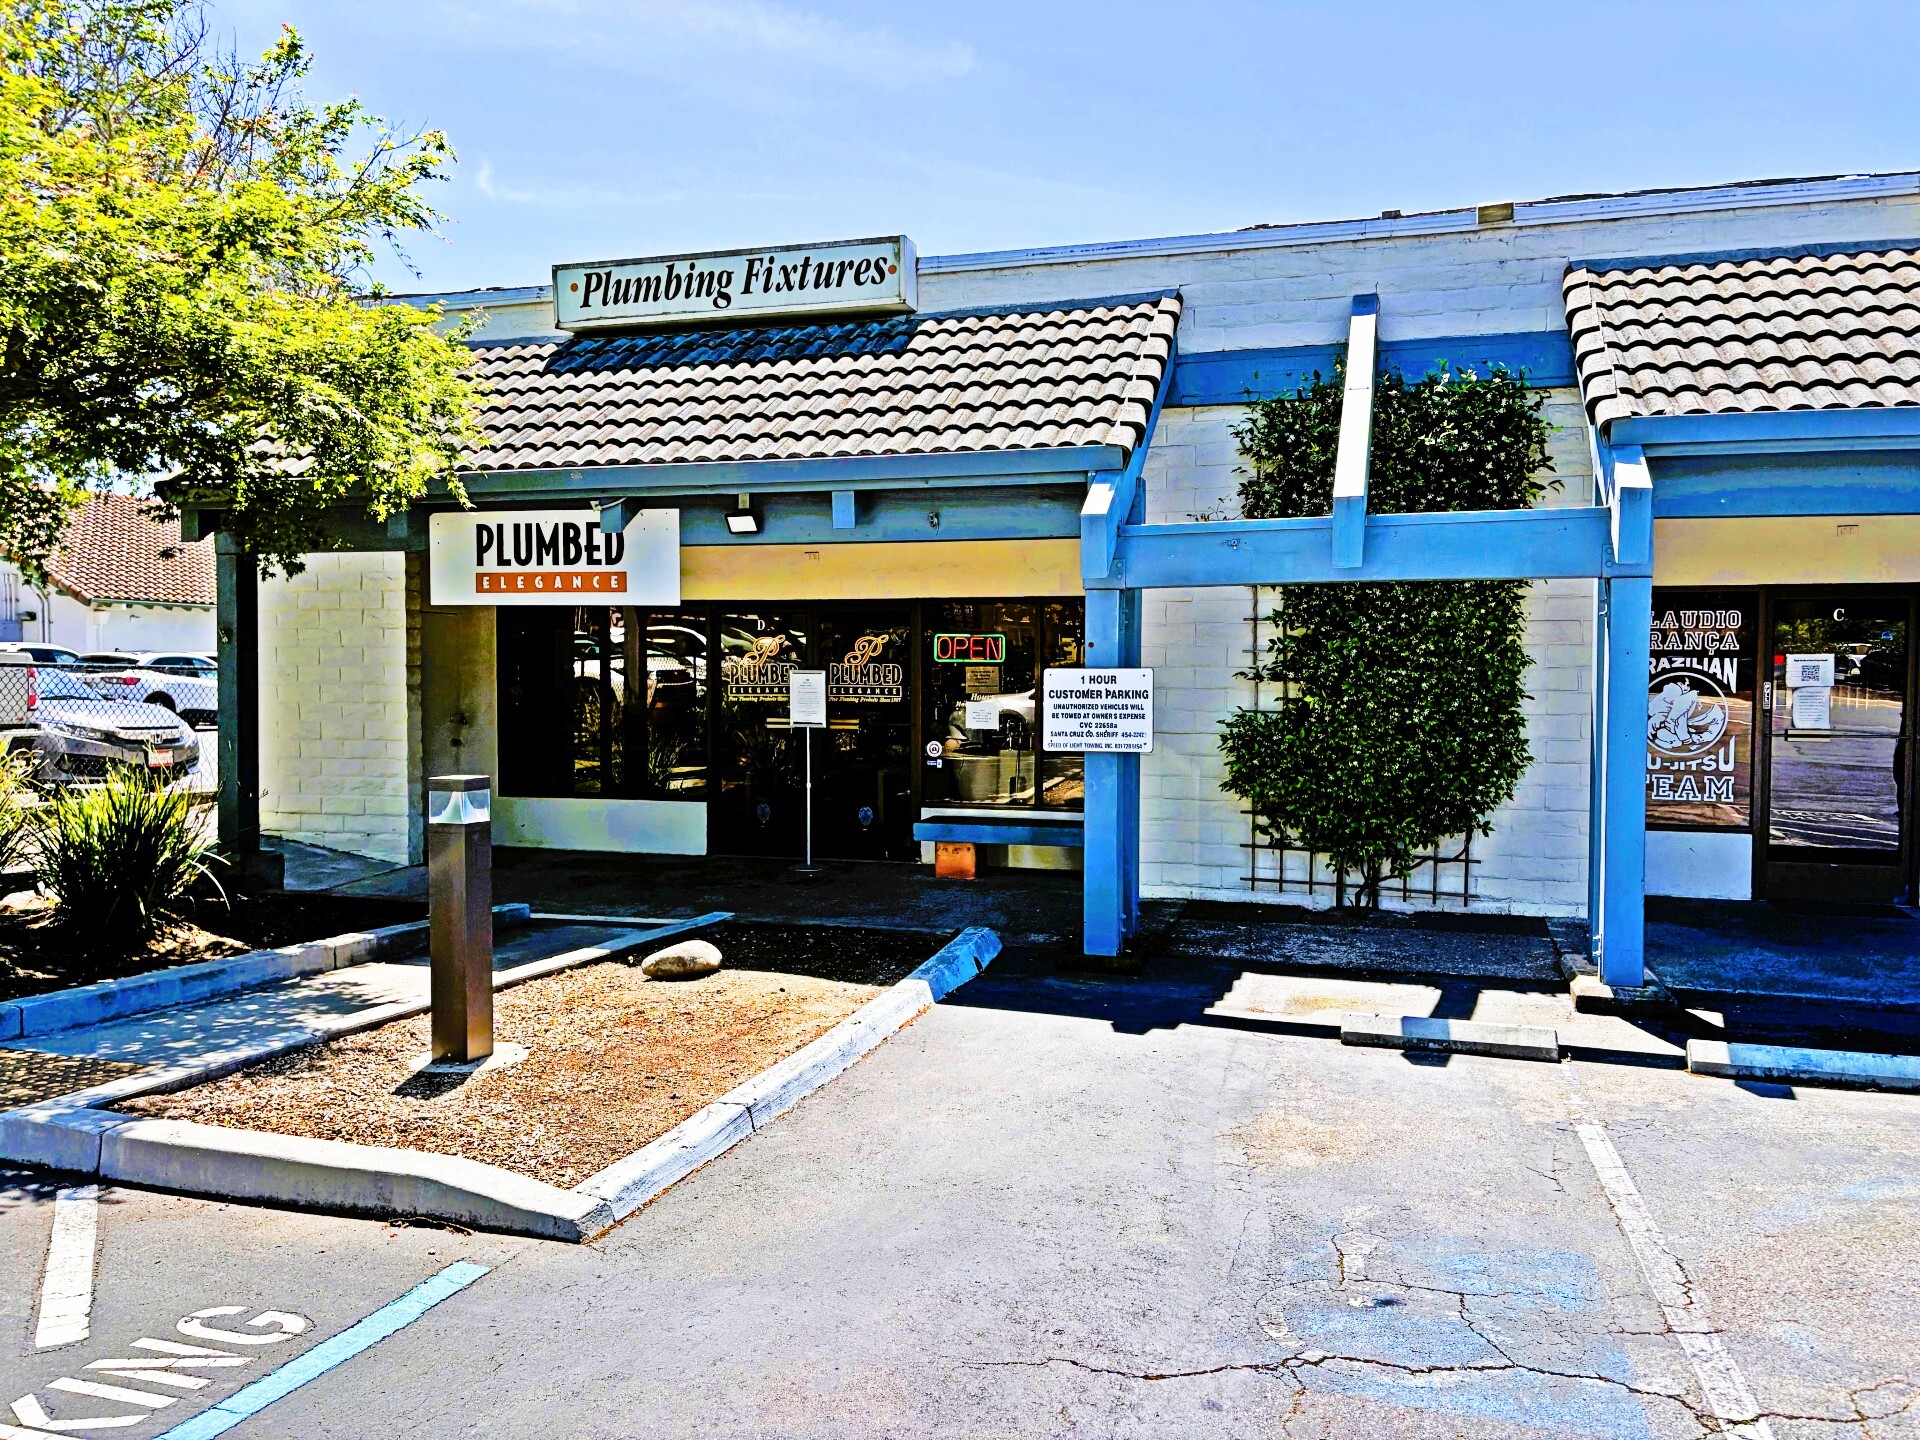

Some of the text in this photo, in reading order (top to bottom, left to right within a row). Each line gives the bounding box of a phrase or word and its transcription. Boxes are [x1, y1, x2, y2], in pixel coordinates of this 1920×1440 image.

[580, 255, 888, 309] Plumbing Fixtures
[475, 521, 625, 566] PLUMBED
[482, 575, 619, 589] ELEGANCE
[1649, 610, 1742, 629] LAUDIO
[1833, 608, 1845, 621] C
[757, 619, 766, 631] D
[937, 636, 1002, 661] OPEN
[1649, 631, 1740, 656] RANÇA
[829, 662, 902, 686] PLUMBED
[1080, 675, 1117, 685] 1 HOUR
[1648, 657, 1738, 694] RAZILIAN
[832, 687, 897, 695] ELEGANCE
[1048, 689, 1149, 700] CUSTOMER PARKING
[1130, 703, 1144, 711] WILL
[1079, 721, 1093, 729] CVC
[1069, 730, 1085, 738] CRUZ
[1647, 735, 1736, 772] U-JITSU
